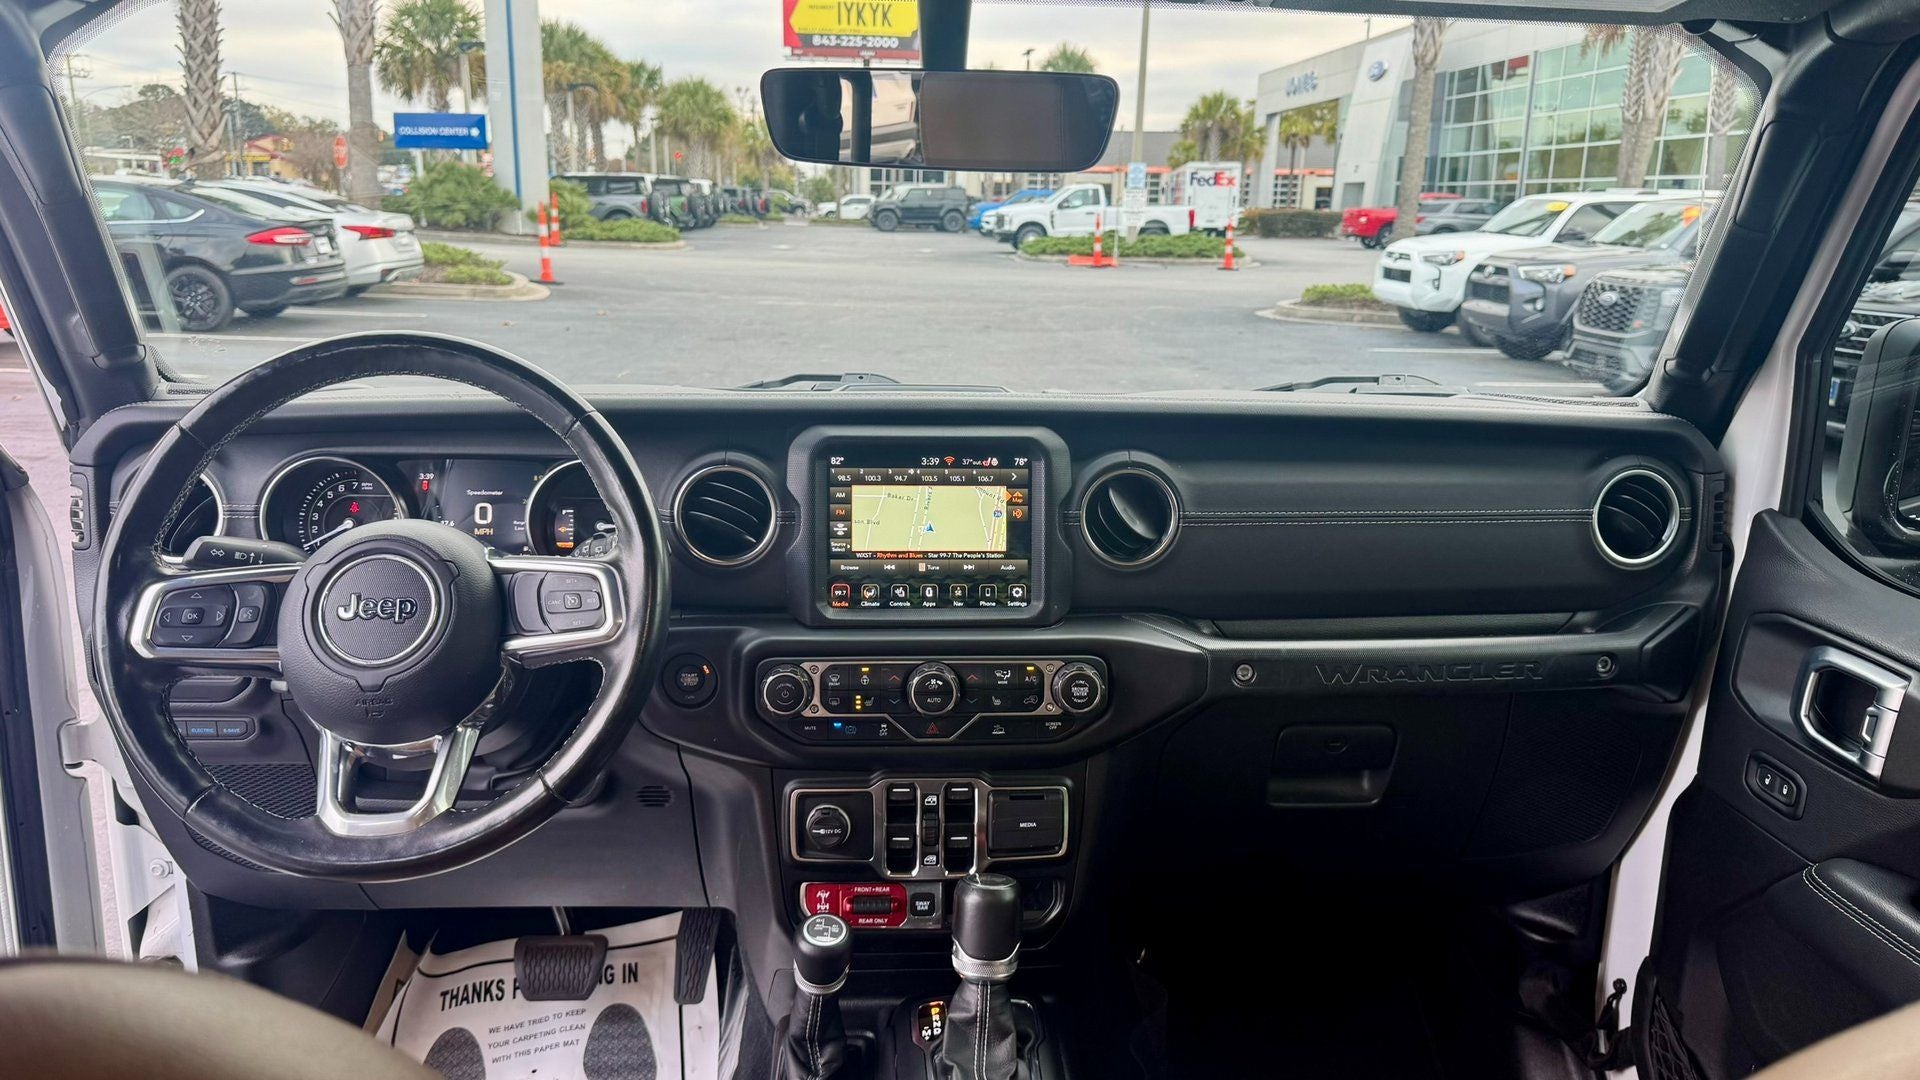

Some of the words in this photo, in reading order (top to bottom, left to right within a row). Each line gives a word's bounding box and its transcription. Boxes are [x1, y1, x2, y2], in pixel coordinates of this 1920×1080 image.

[837, 2, 893, 27] IYKYK
[812, 34, 900, 49] 843-225-2000
[439, 127, 469, 136] CENTER
[1189, 171, 1236, 187] FedEx
[921, 457, 940, 466] 3:39
[338, 484, 345, 492] 6
[351, 481, 359, 490] 7
[326, 490, 334, 499] 5
[466, 488, 503, 497] Speedometer
[316, 500, 324, 508] 4
[312, 512, 319, 521] 3
[473, 501, 494, 526] 0
[311, 525, 318, 534] 2
[473, 527, 494, 537] MPH
[877, 552, 897, 560] Rhythm
[337, 593, 418, 624] Jeep
[187, 612, 198, 620] OK
[1315, 659, 1543, 685] WRANGLER
[622, 961, 639, 984] IN
[440, 978, 506, 1012] THANKS
[488, 1023, 502, 1034] WE
[503, 1021, 525, 1032] HAVE
[528, 1016, 550, 1027] TRIED
[553, 1012, 564, 1022] TO
[565, 1008, 587, 1018] KEEP
[488, 1039, 510, 1050] YOUR
[512, 1028, 557, 1044] CARPETING
[559, 1023, 587, 1033] CLEAN
[492, 1054, 512, 1064] WITH
[514, 1048, 532, 1058] THIS
[533, 1041, 560, 1054] PAPER
[563, 1038, 582, 1048] MAT
